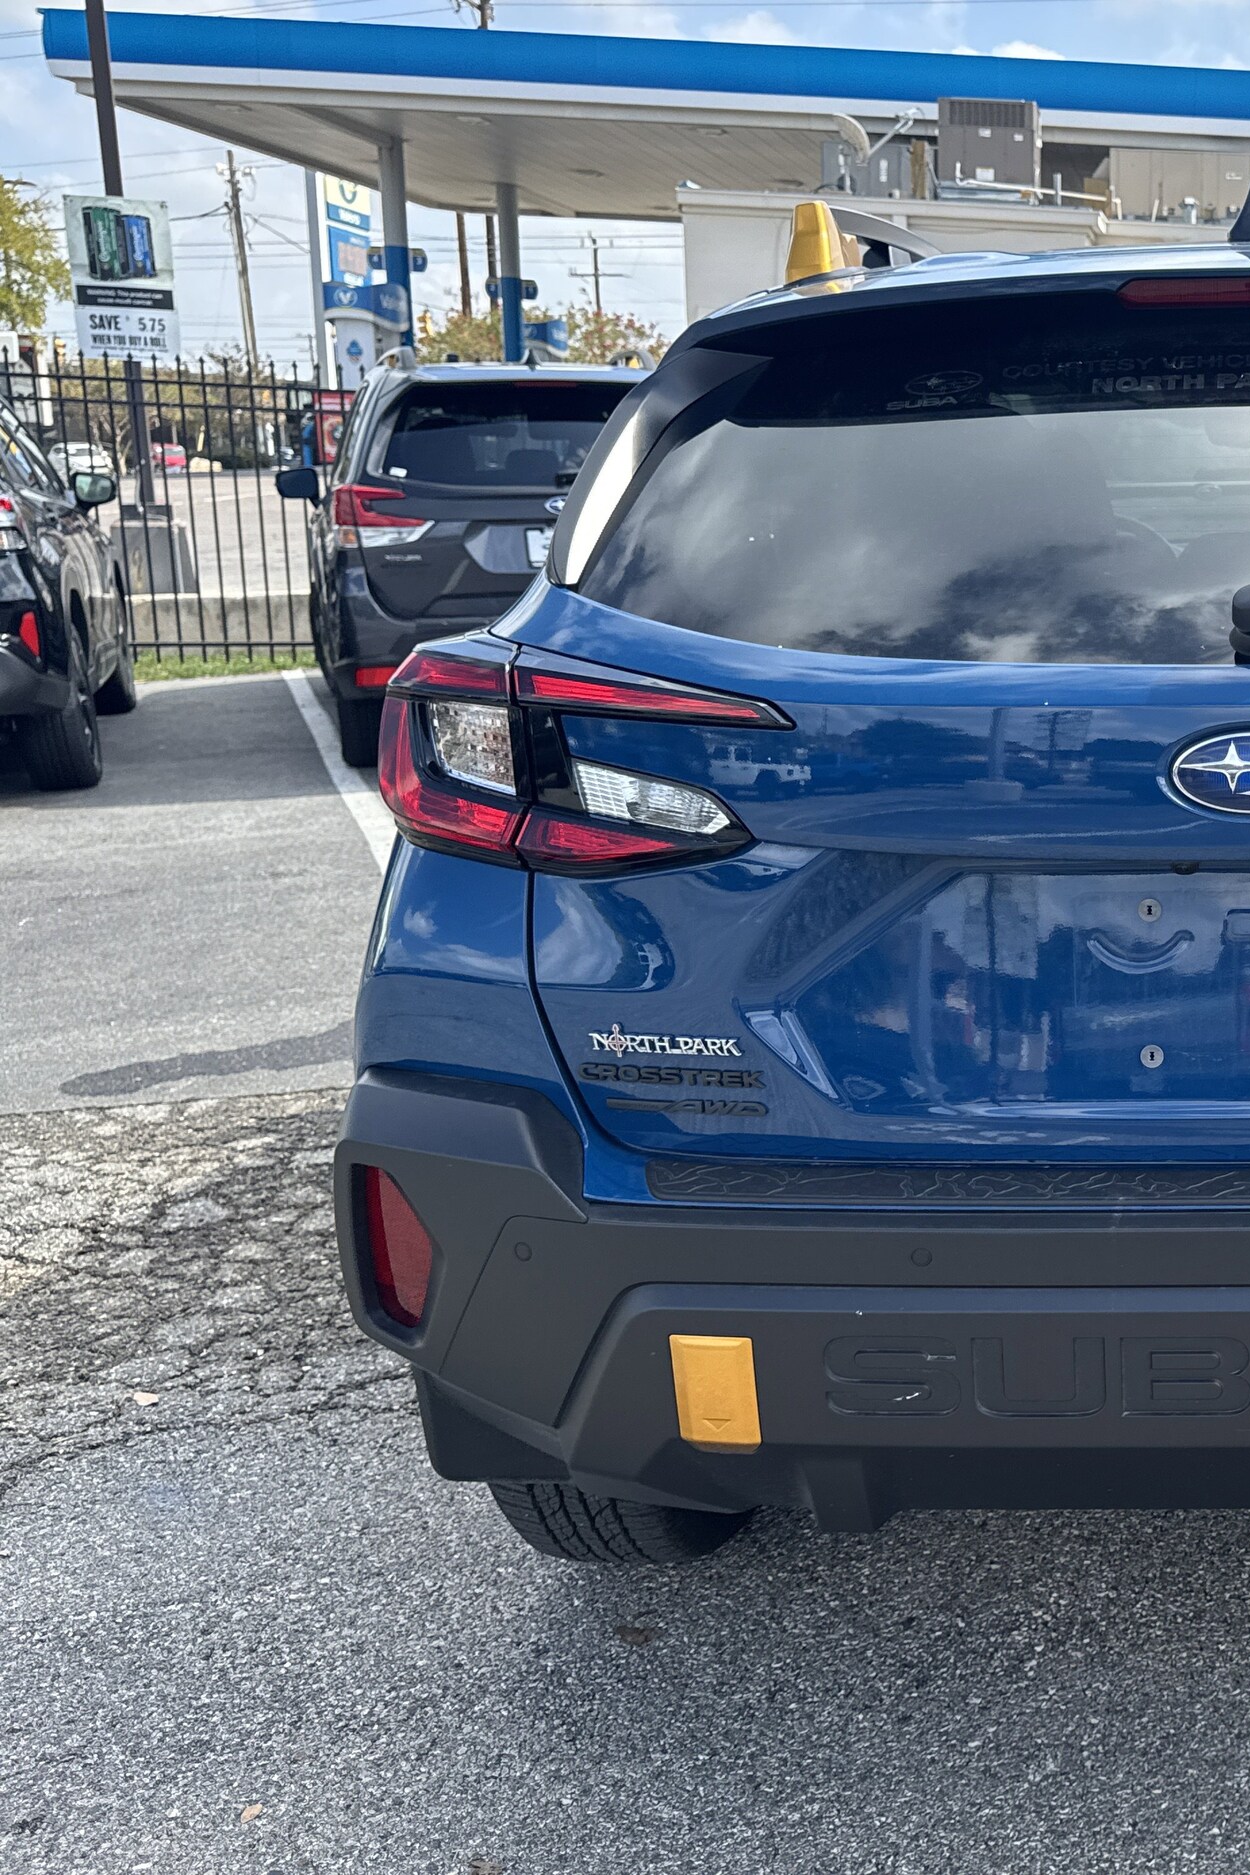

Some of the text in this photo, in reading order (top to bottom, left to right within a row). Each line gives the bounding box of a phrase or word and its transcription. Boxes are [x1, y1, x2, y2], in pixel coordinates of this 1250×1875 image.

[89, 314, 121, 331] SAVE
[143, 337, 149, 346] A
[1003, 356, 1154, 378] COURTESY
[1092, 373, 1206, 395] NORTH
[886, 393, 974, 411] SUBA
[588, 1025, 743, 1057] NORTH PARK
[578, 1063, 768, 1089] CROSSTREK
[664, 1098, 769, 1117] AWD
